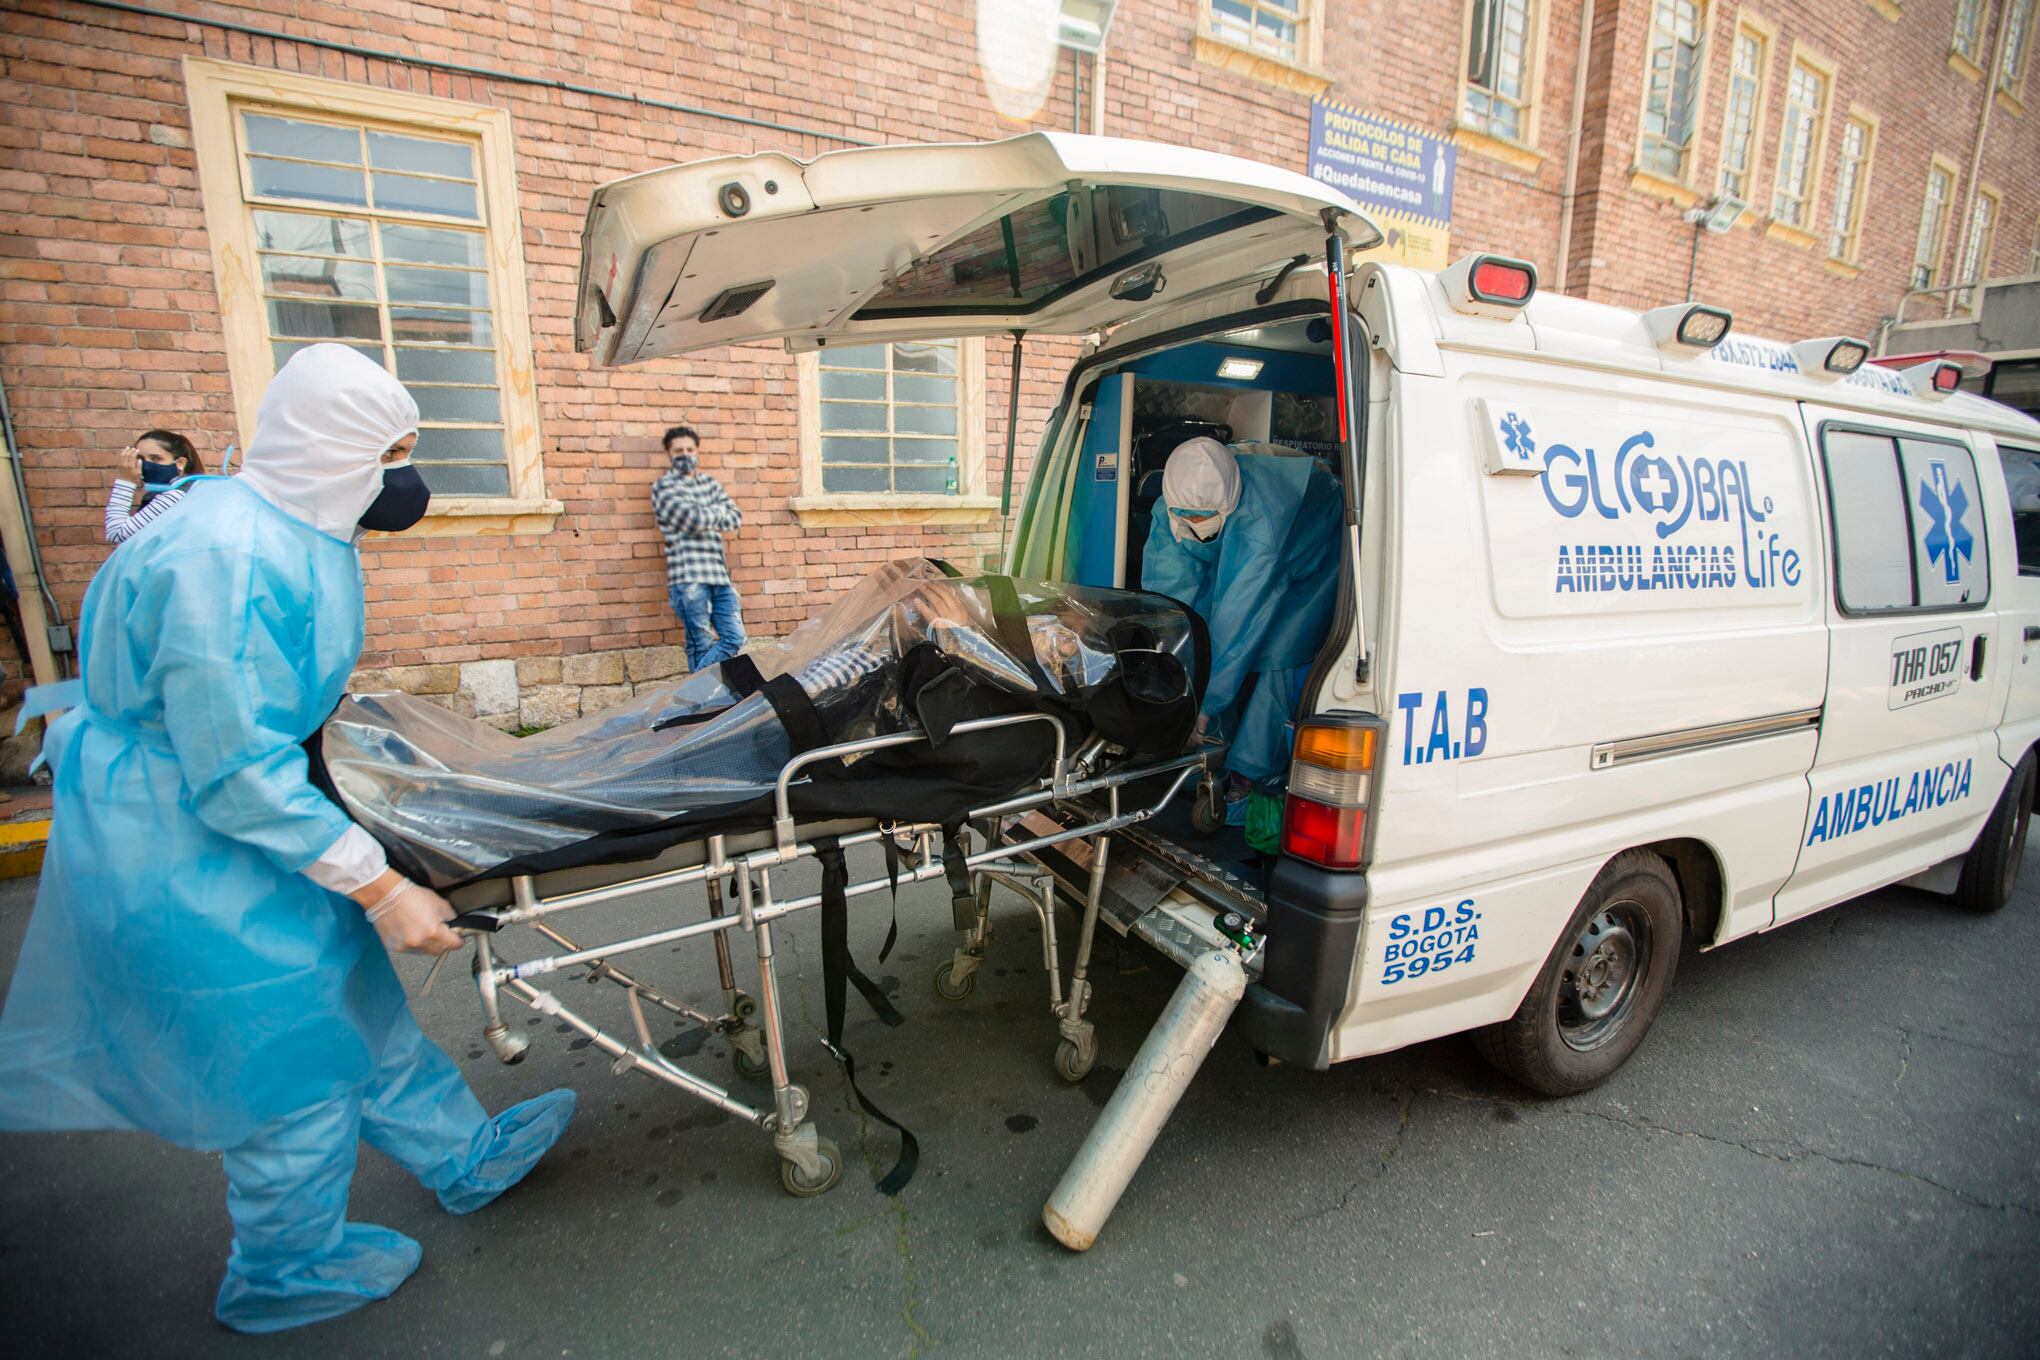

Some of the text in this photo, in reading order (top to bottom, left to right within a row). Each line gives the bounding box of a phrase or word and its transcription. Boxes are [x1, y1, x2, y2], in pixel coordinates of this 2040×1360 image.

[1324, 112, 1423, 153] PROTOCOLOS DE
[1325, 129, 1421, 170] SALIDA DE CASA
[1313, 163, 1422, 205] #Quedateencasa
[1317, 146, 1426, 183] ACCIONES FRENTE AL COVID-19
[1556, 545, 1736, 593] AMBULANCIAS
[1893, 640, 1961, 686] THR 057
[1398, 687, 1488, 766] T.A.B
[1807, 758, 1973, 847] AMBULANCIA
[1388, 898, 1482, 941] S.D.S.
[1384, 923, 1479, 963] BOGOTA
[1380, 944, 1475, 986] 5954
